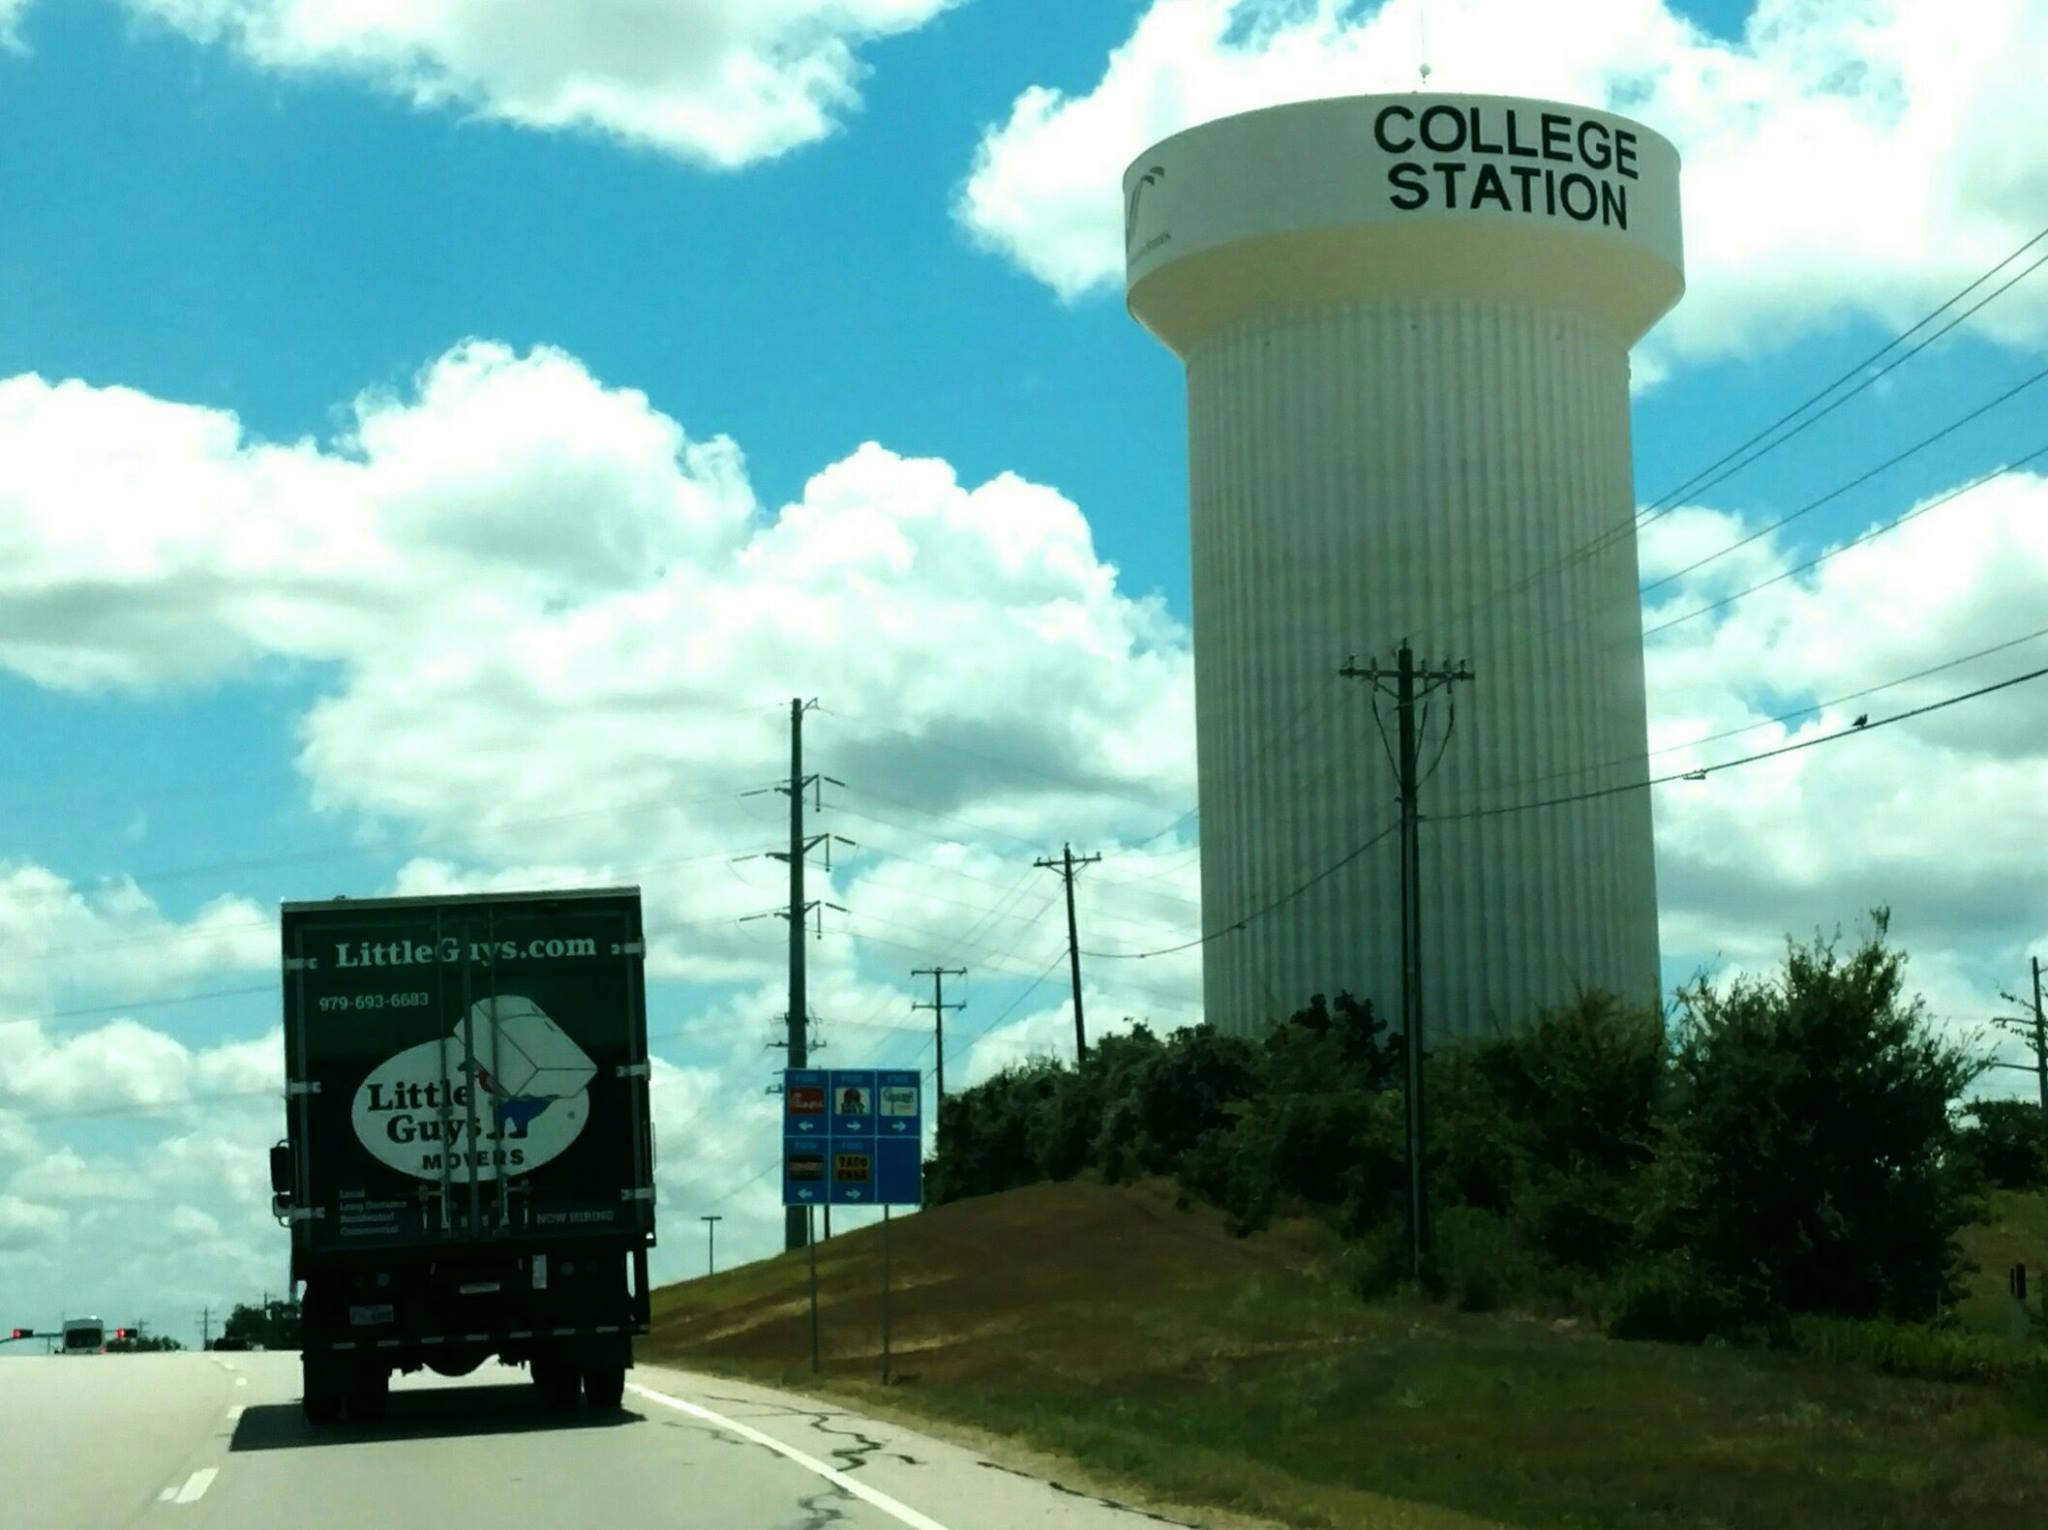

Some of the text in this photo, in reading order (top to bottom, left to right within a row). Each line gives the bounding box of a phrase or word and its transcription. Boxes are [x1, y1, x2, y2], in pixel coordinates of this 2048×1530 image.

[1374, 104, 1639, 181] COLLEGE
[1388, 162, 1628, 231] STATION
[335, 936, 598, 968] LittleGuys.com
[319, 992, 429, 1012] 979-693-6683
[367, 1079, 471, 1112] Little
